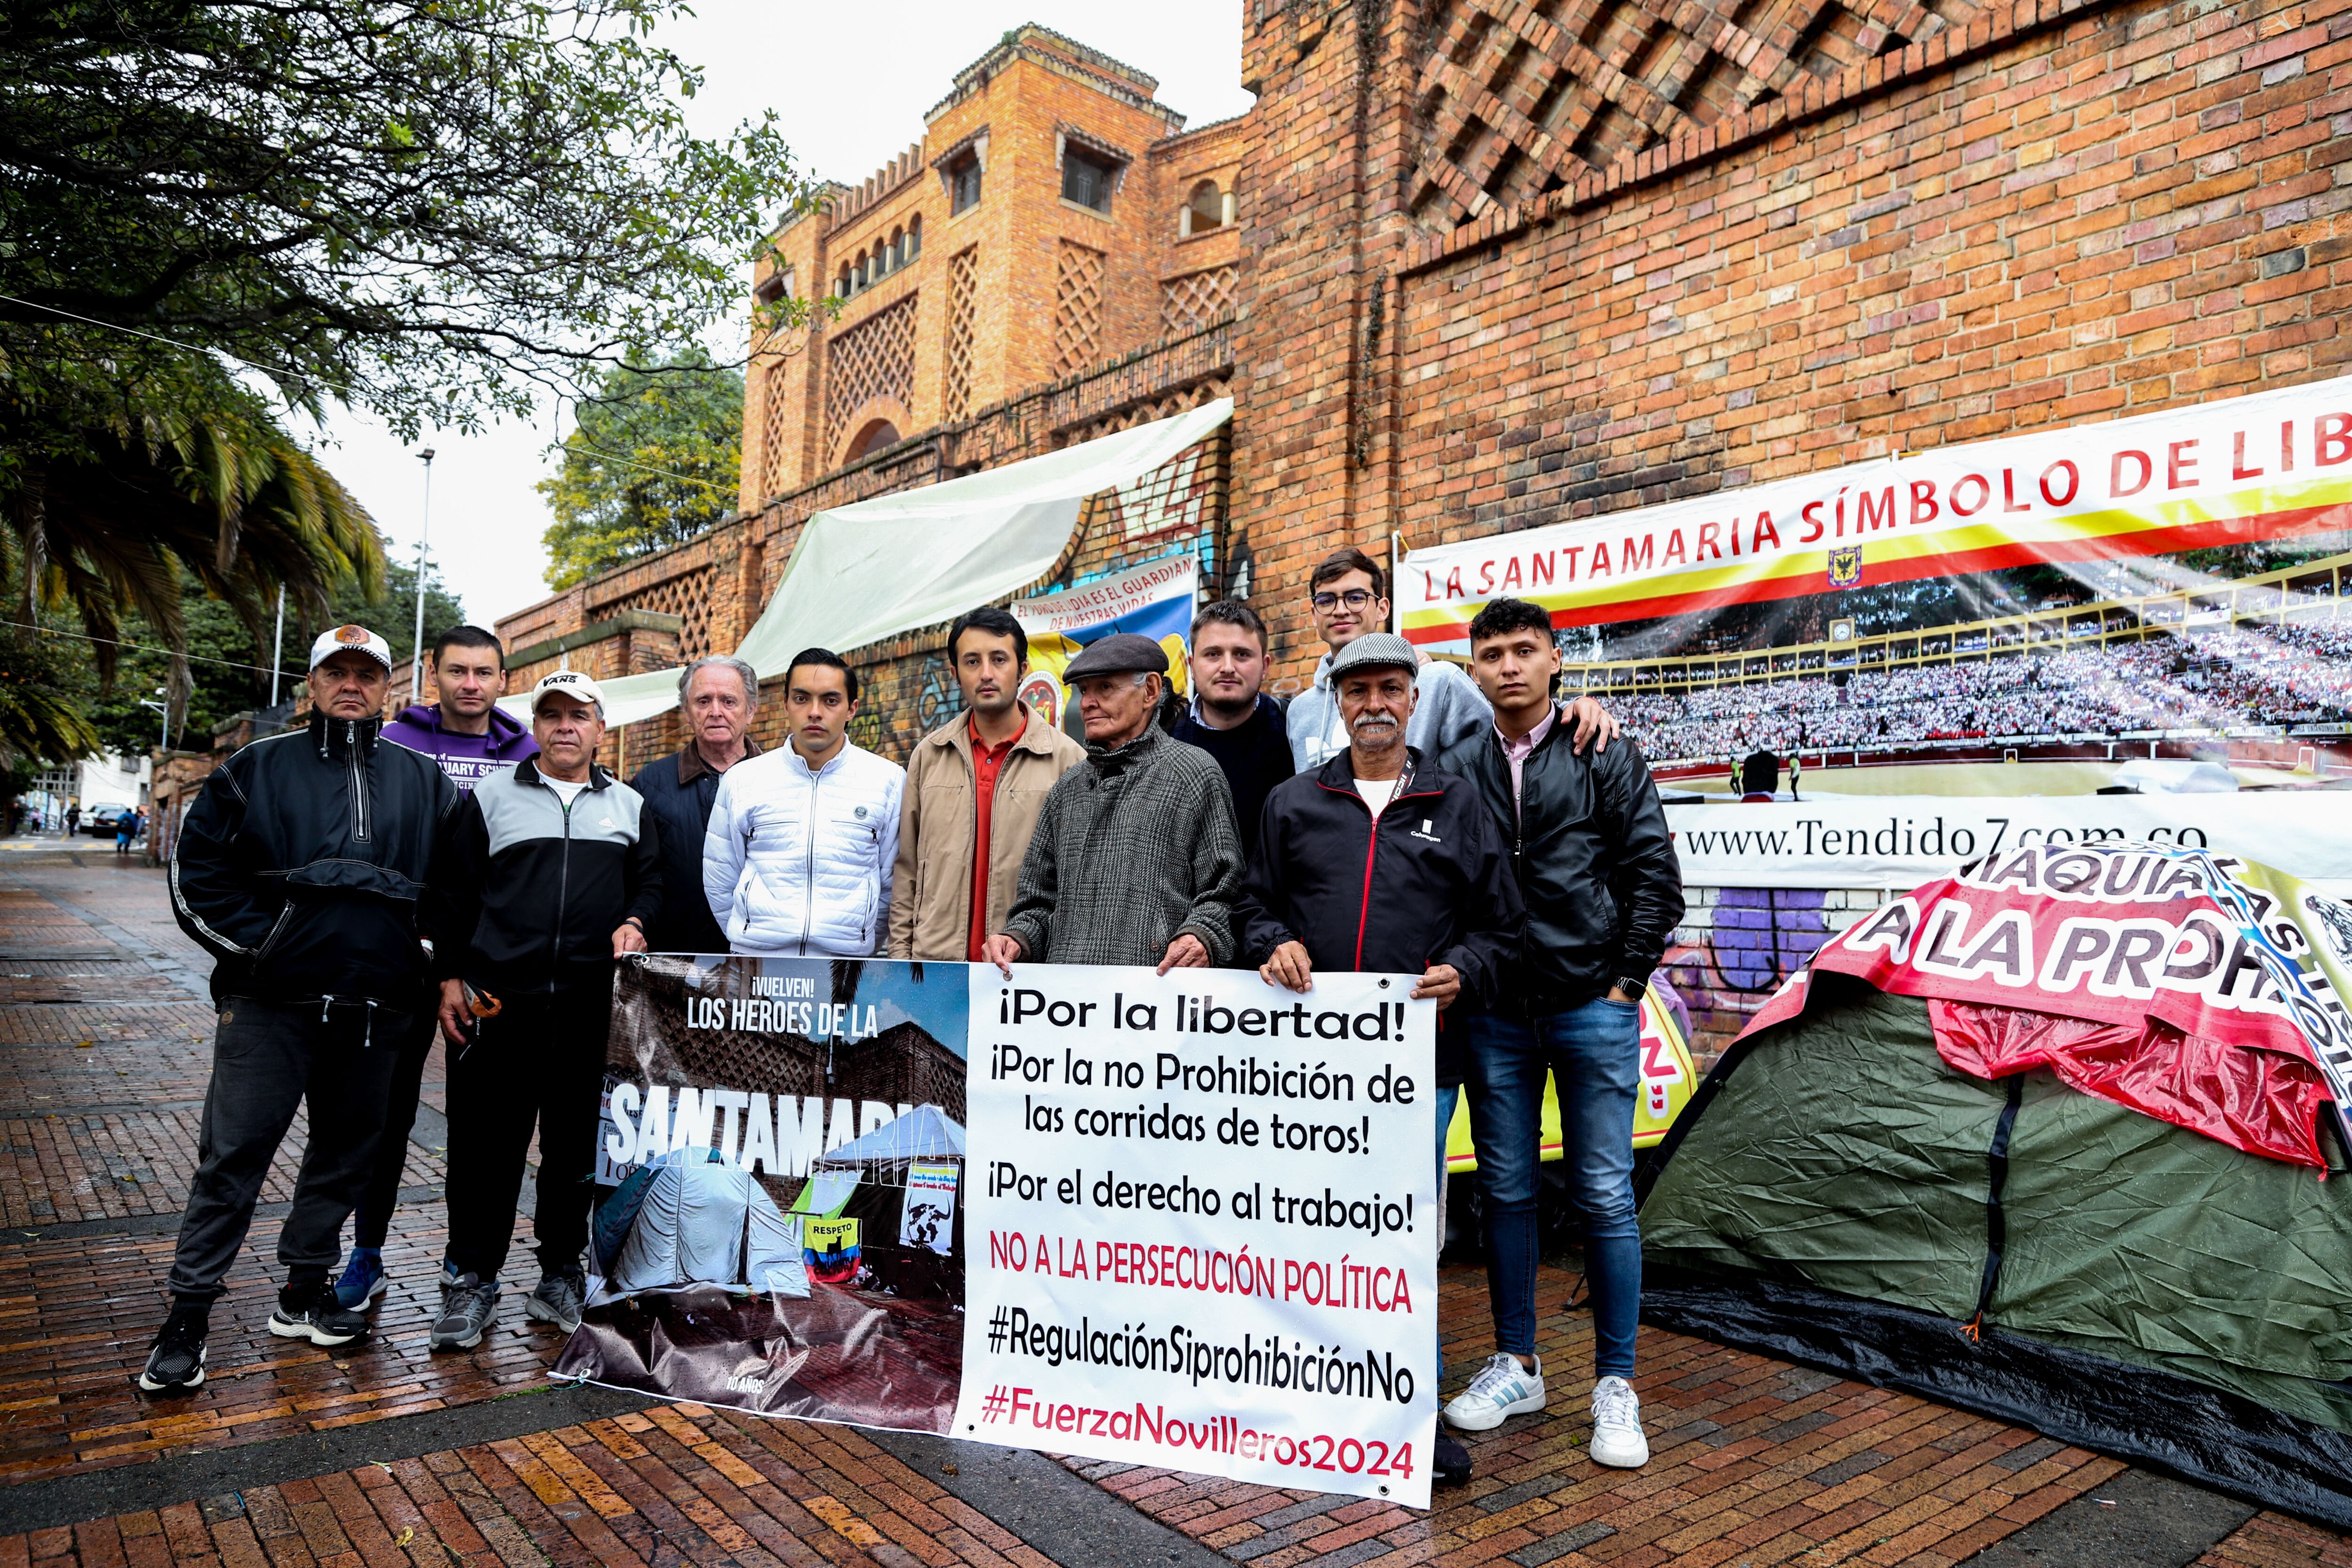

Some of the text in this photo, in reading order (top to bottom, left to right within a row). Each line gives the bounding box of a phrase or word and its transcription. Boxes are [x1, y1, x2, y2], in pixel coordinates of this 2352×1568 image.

[1425, 566, 1465, 602] LA
[1477, 510, 1781, 595] SANTAMARIA
[1800, 459, 2079, 542] SÍMBOLO
[2110, 439, 2200, 498] DE
[1017, 605, 1028, 617] EL
[1029, 603, 1054, 615] TORO
[1050, 601, 1066, 612] DE
[1063, 595, 1093, 611] LIDIA
[1090, 589, 1106, 604] ES
[1105, 586, 1123, 600] EL
[1049, 617, 1064, 630] DE
[1065, 606, 1118, 628] NUESTRAS
[543, 675, 578, 687] VANS
[1411, 831, 1441, 843] Colwagen
[1685, 817, 2207, 857] www.Tendido7comco
[1858, 904, 2285, 1003] A LA PROH
[752, 976, 814, 998] ¡VUELVEN!
[688, 997, 878, 1038] LOS HEROES DE LA
[1000, 988, 1405, 1042] ¡Por la libertad!
[992, 1044, 1414, 1105] ¡Por la no Prohibición de
[606, 1083, 953, 1190] SANTAMARIA
[1025, 1094, 1369, 1155] las corridas de toros!
[989, 1161, 1413, 1237] ¡Por el derecho al trabajo!
[813, 1223, 852, 1234] RESPETO
[990, 1230, 1412, 1314] NO A LA PERSECUCIÓN POLÍTICA
[988, 1305, 1414, 1404] #RegulaciónSiprohibiciónNo
[726, 1375, 765, 1394] 10 AÑOS
[982, 1385, 1414, 1479] #FuerzaNovilleros2024
